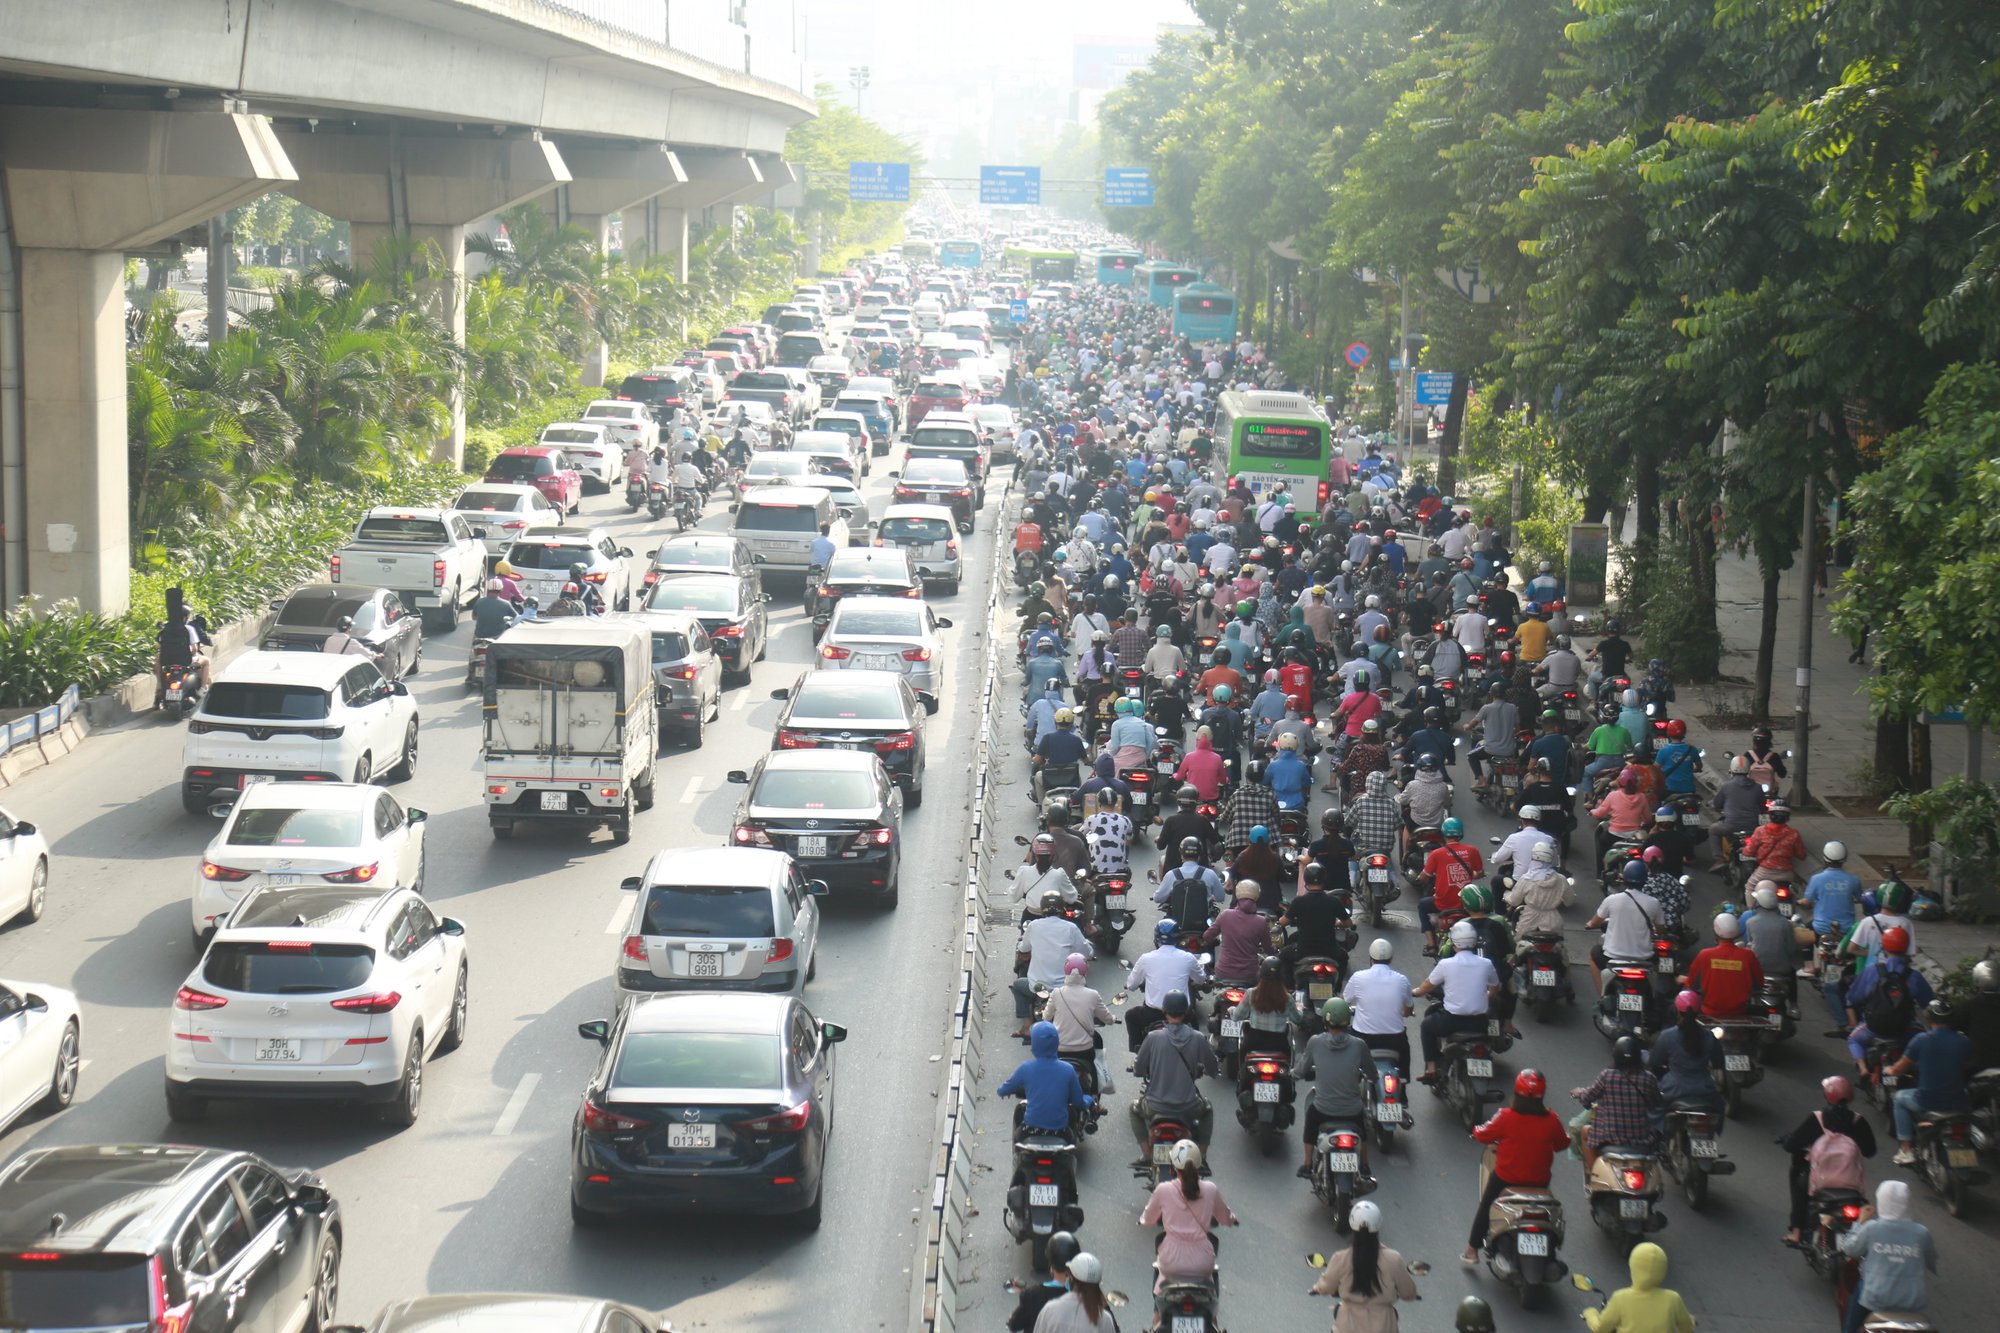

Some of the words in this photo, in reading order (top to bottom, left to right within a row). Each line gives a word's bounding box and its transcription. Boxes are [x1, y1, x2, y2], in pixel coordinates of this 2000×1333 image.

[547, 793, 562, 801] 29H
[806, 838, 820, 846] 18A
[276, 875, 293, 885] 30A
[696, 954, 716, 964] 30S
[694, 965, 717, 975] 9918
[268, 1038, 288, 1049] 30H
[260, 1049, 295, 1059] 307.94
[682, 1125, 703, 1135] 30H
[673, 1136, 711, 1147] 013.35
